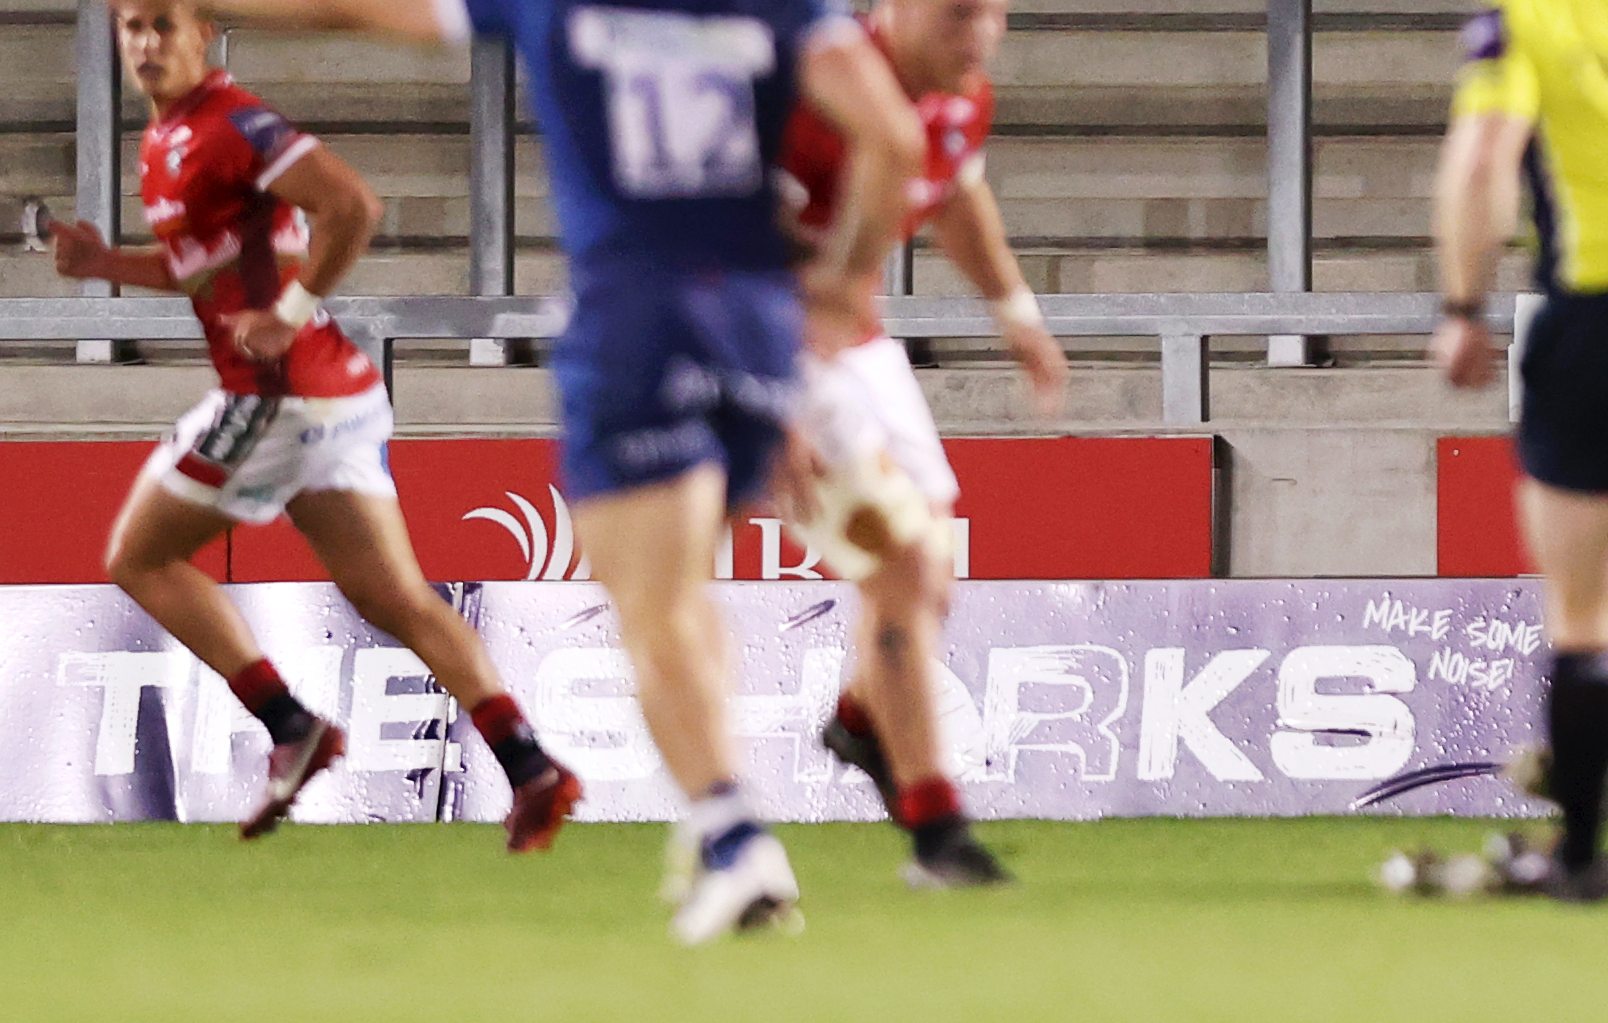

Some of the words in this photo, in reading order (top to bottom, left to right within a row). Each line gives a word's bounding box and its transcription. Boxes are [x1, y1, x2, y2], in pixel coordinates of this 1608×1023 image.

[629, 69, 754, 185] 12
[1363, 598, 1453, 641] MAKE
[1466, 617, 1544, 656] SOME
[1428, 646, 1514, 690] NOISE!
